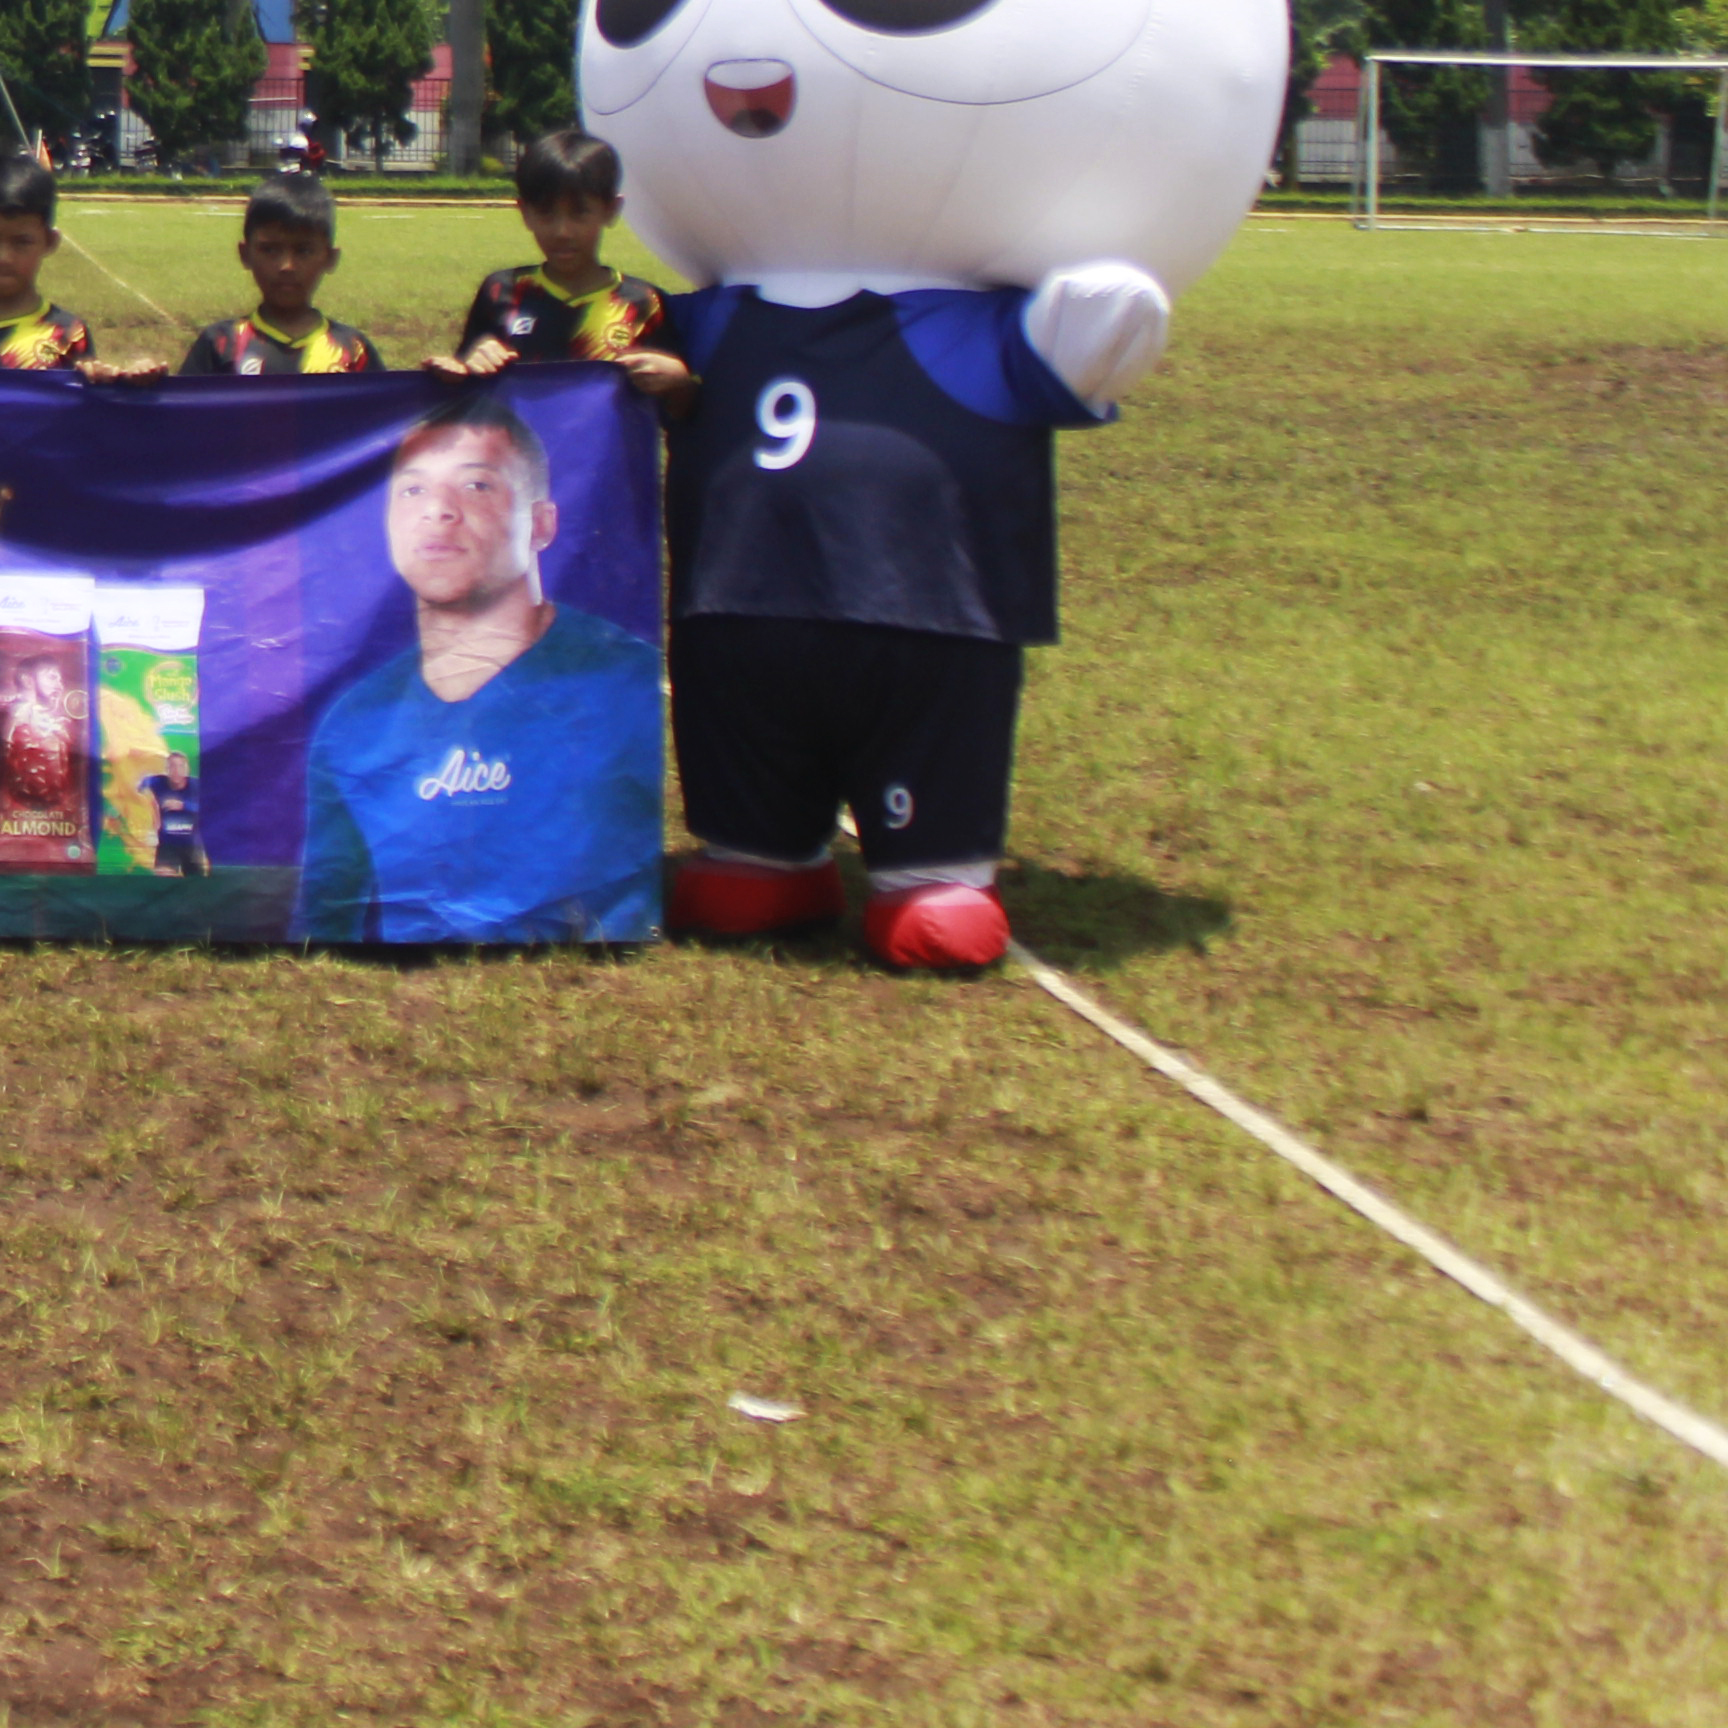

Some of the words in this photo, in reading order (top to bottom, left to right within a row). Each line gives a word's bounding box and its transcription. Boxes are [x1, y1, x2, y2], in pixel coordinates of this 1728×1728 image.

[754, 380, 817, 471] 9
[419, 748, 512, 801] Aice
[0, 820, 77, 837] ALMOND
[12, 809, 65, 820] CHOCOLATE
[882, 784, 915, 831] 9
